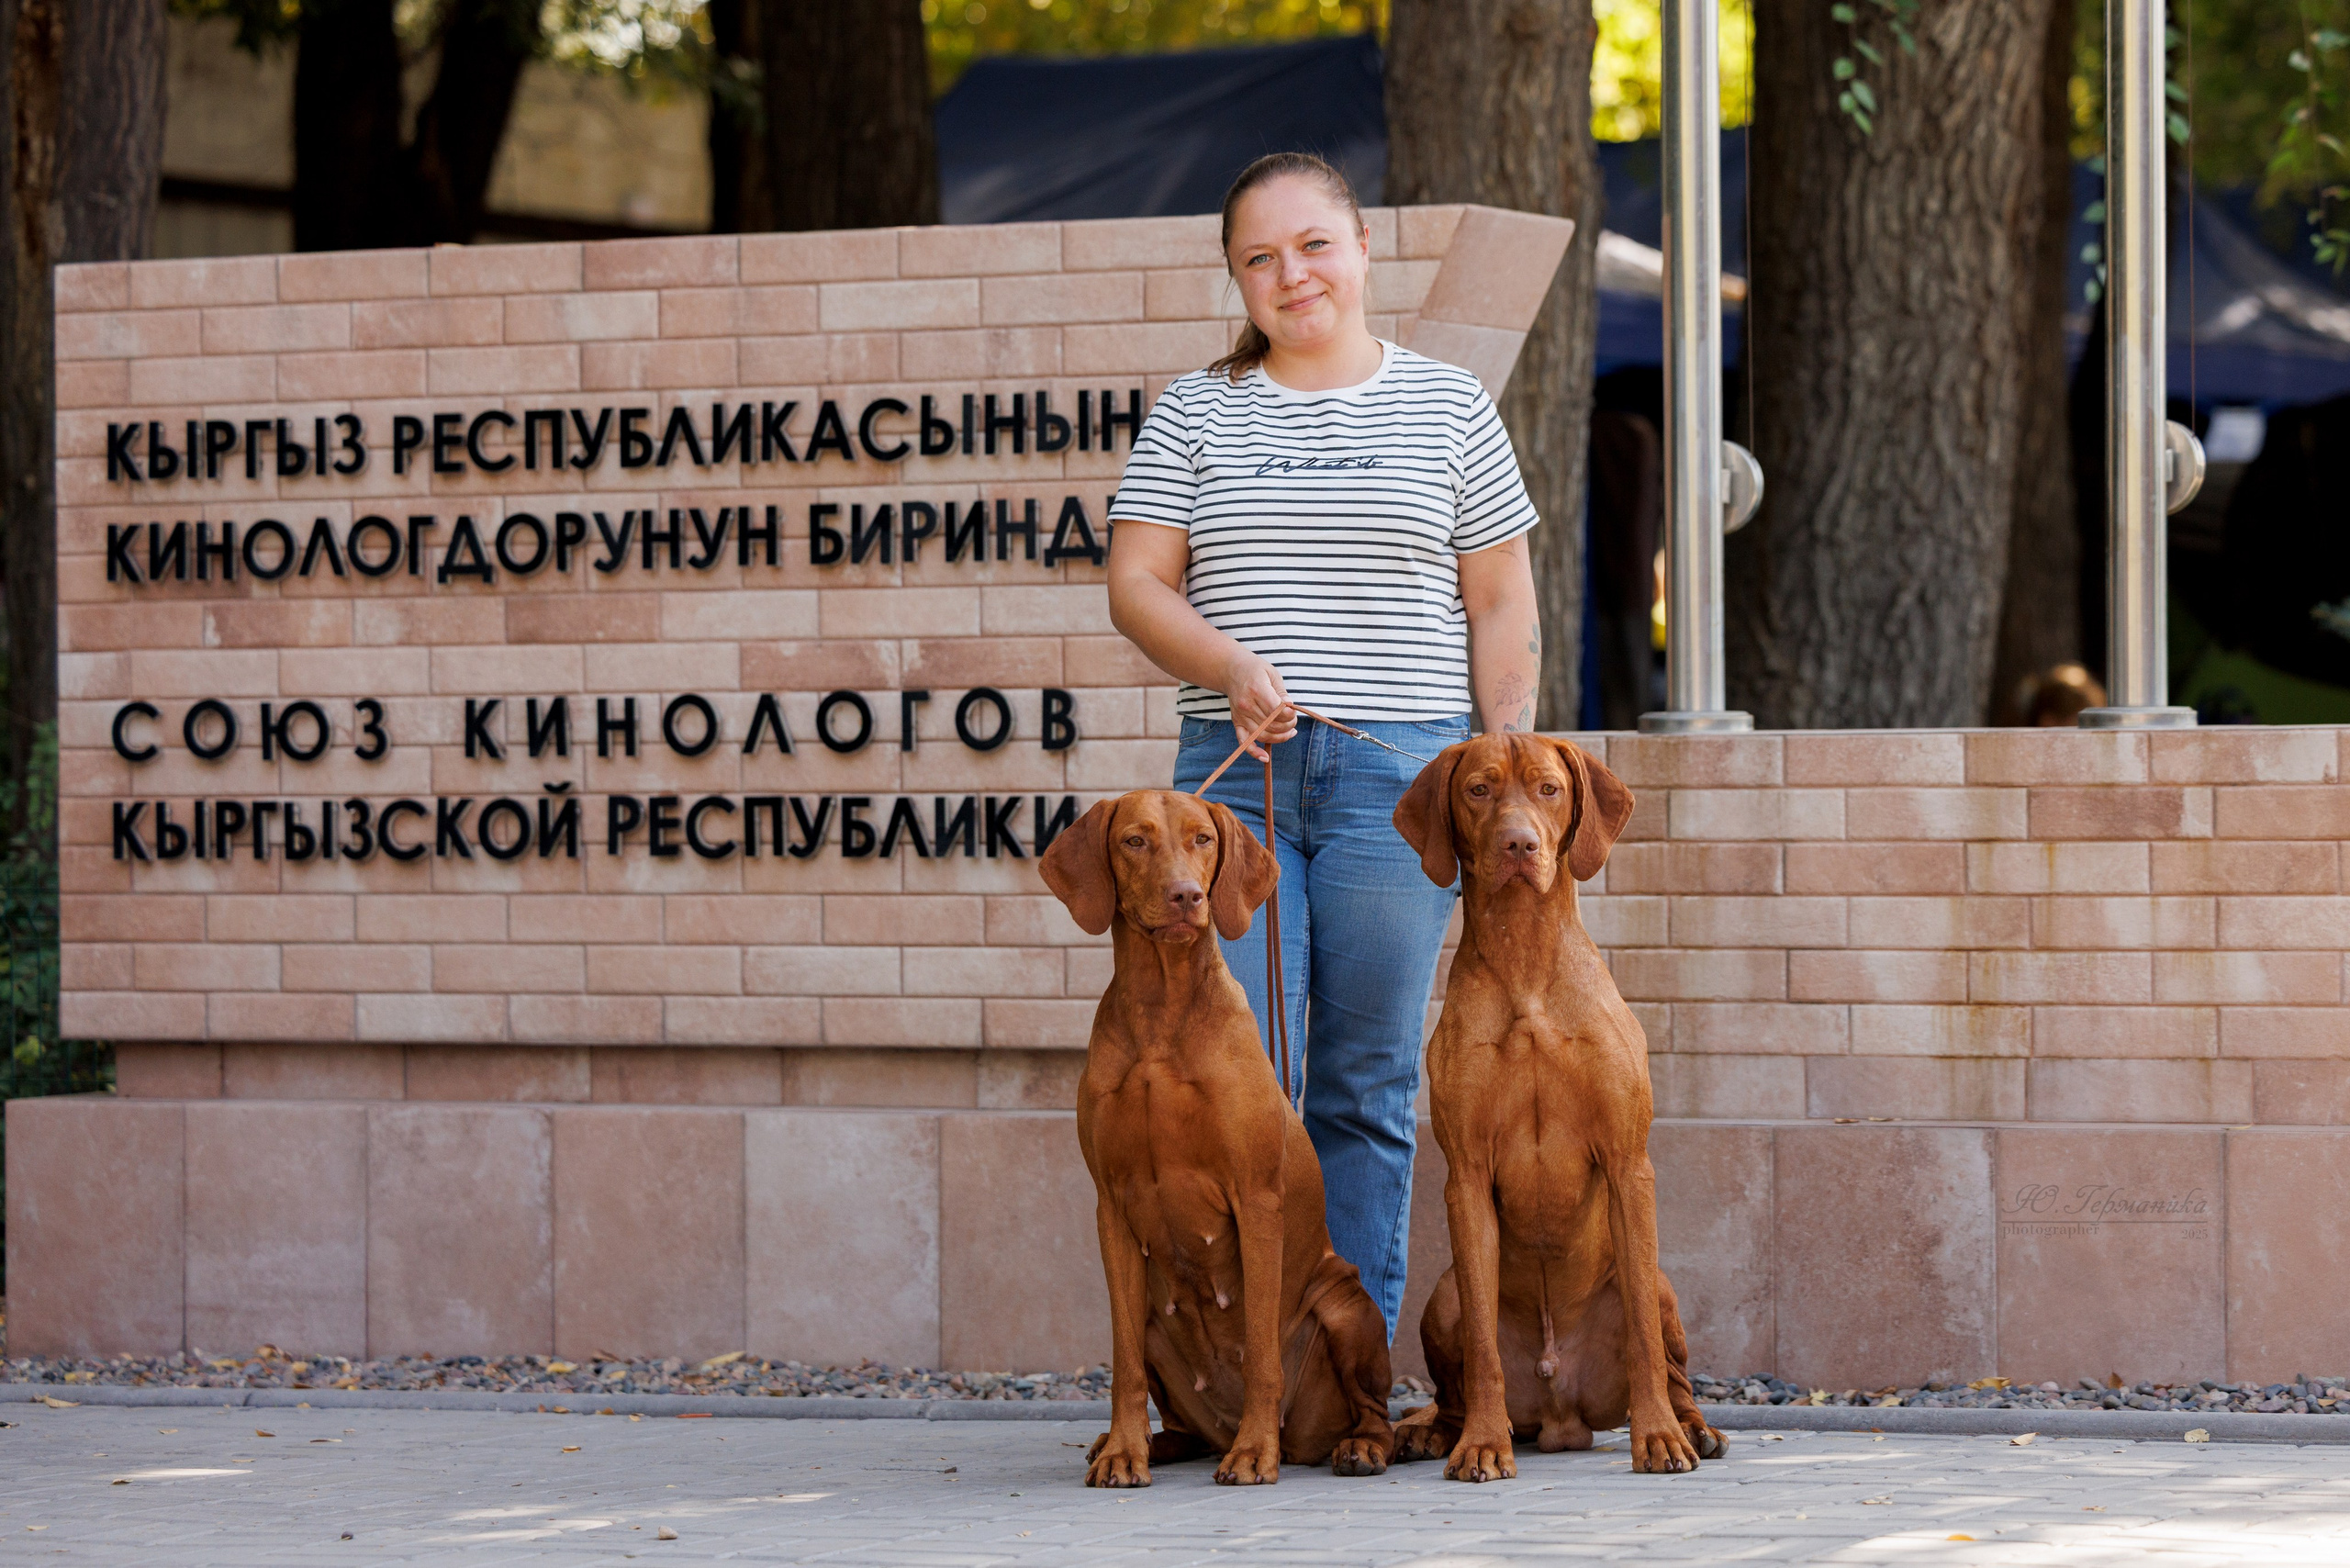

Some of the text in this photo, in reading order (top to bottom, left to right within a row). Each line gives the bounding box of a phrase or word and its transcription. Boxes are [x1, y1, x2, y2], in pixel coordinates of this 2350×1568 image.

[106, 388, 1142, 481] КЫРГЫЗ РЕСПУБЛИКАСЫНЫН
[106, 495, 1117, 583] КИНОЛОГДОРУНУН БИРИНД
[111, 687, 1079, 761] СОЮЗ КИНОЛОГОВ
[112, 781, 1076, 862] КЫРГЫЗСКОЙ РЕСПУБЛИКИ
